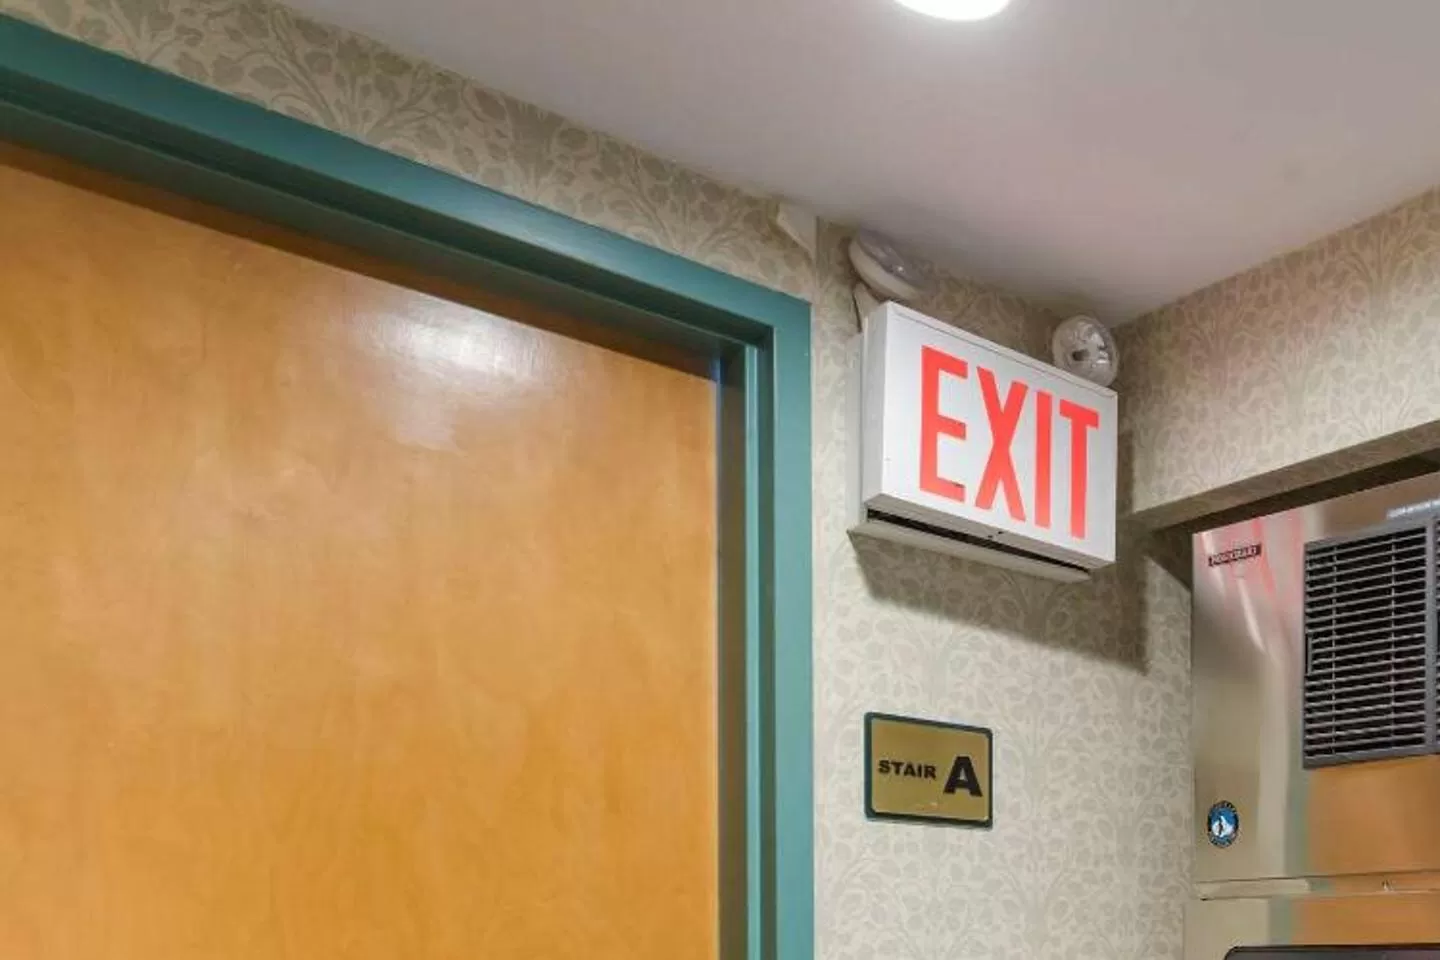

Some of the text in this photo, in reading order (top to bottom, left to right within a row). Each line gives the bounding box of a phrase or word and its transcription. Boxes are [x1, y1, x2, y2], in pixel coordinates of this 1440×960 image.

[919, 345, 1100, 540] EXIT
[878, 755, 983, 797] STAIR A
